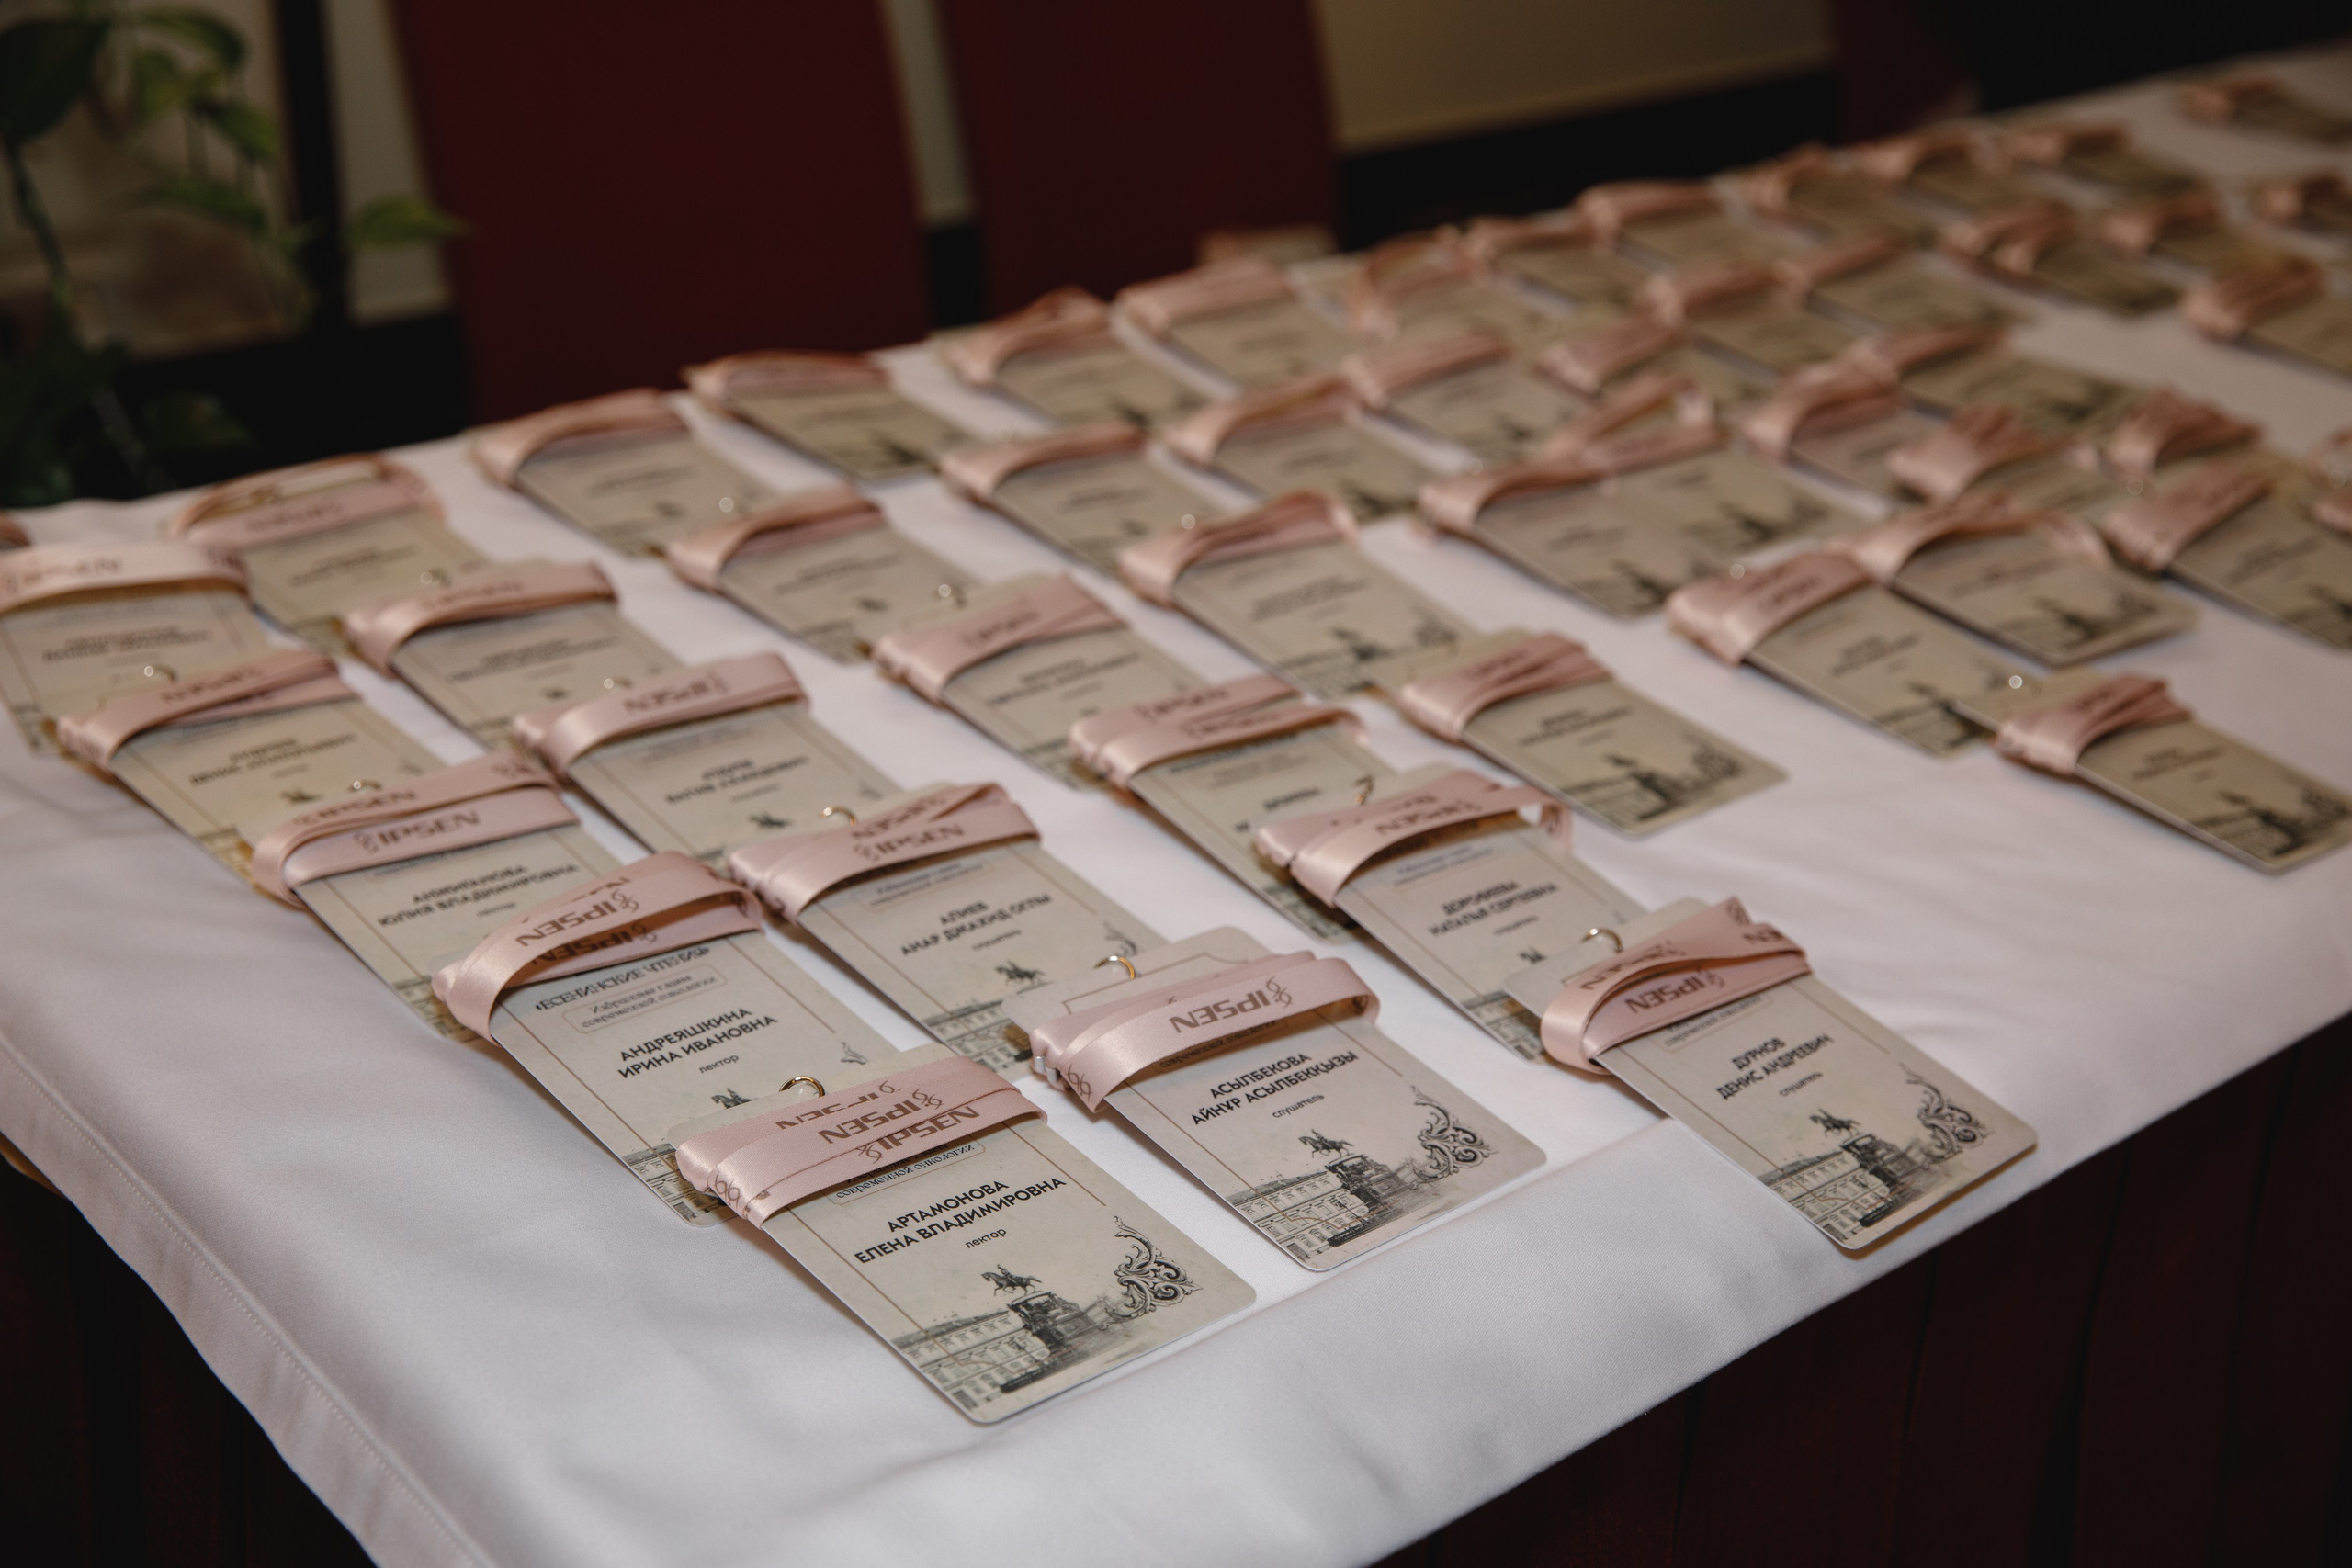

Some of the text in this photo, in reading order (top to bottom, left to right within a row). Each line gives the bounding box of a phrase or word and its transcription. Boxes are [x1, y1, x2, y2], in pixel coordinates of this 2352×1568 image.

[378, 810, 481, 845] IPSEN
[514, 901, 617, 947] IPSEN
[1169, 989, 1271, 1033] IPSEN
[1624, 976, 1707, 1014] IPSEN
[616, 1015, 778, 1080] ИРИНА ИВАНОВНА
[619, 1008, 752, 1063] АНДРЕЯШКИНА
[1731, 1037, 1787, 1071] ДУРНОВ
[698, 1055, 739, 1074] лектор
[1209, 1053, 1312, 1099] АСЫЛБЕКОВА
[1715, 1033, 1835, 1100] ДЕНИС АНДРЕЕВИЧ
[818, 1100, 921, 1145] IPSEN
[877, 1106, 980, 1151] IPSEN
[1272, 1093, 1325, 1119] слушатель
[836, 1145, 975, 1199] современной онкологии
[854, 1178, 1067, 1264] ЕЛЕНА ВЛАДИМИРОВНА
[888, 1180, 1010, 1233] АРТАМОНОВА
[965, 1227, 1007, 1248] лектор
